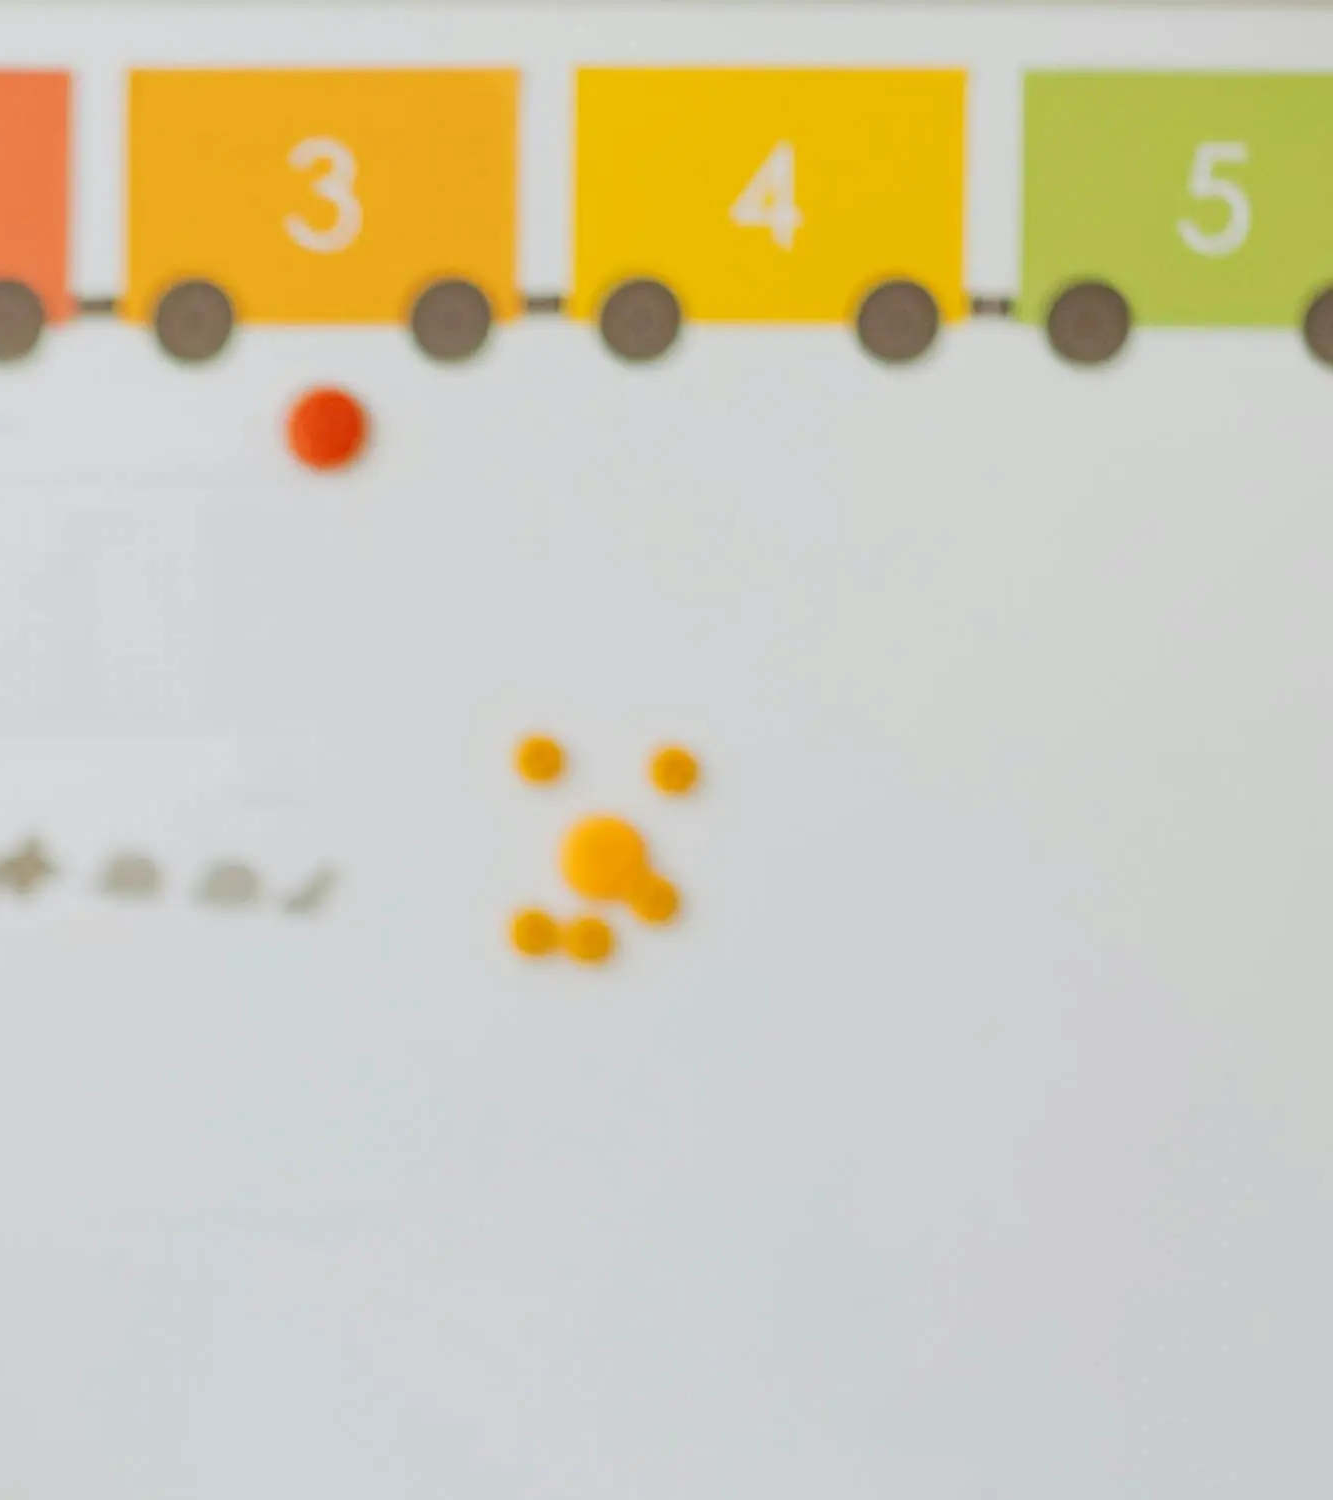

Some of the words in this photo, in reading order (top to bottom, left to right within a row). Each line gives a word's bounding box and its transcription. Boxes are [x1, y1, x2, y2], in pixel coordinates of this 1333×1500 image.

[284, 136, 364, 254] 3
[729, 140, 804, 250] 4
[1176, 140, 1253, 258] 5
